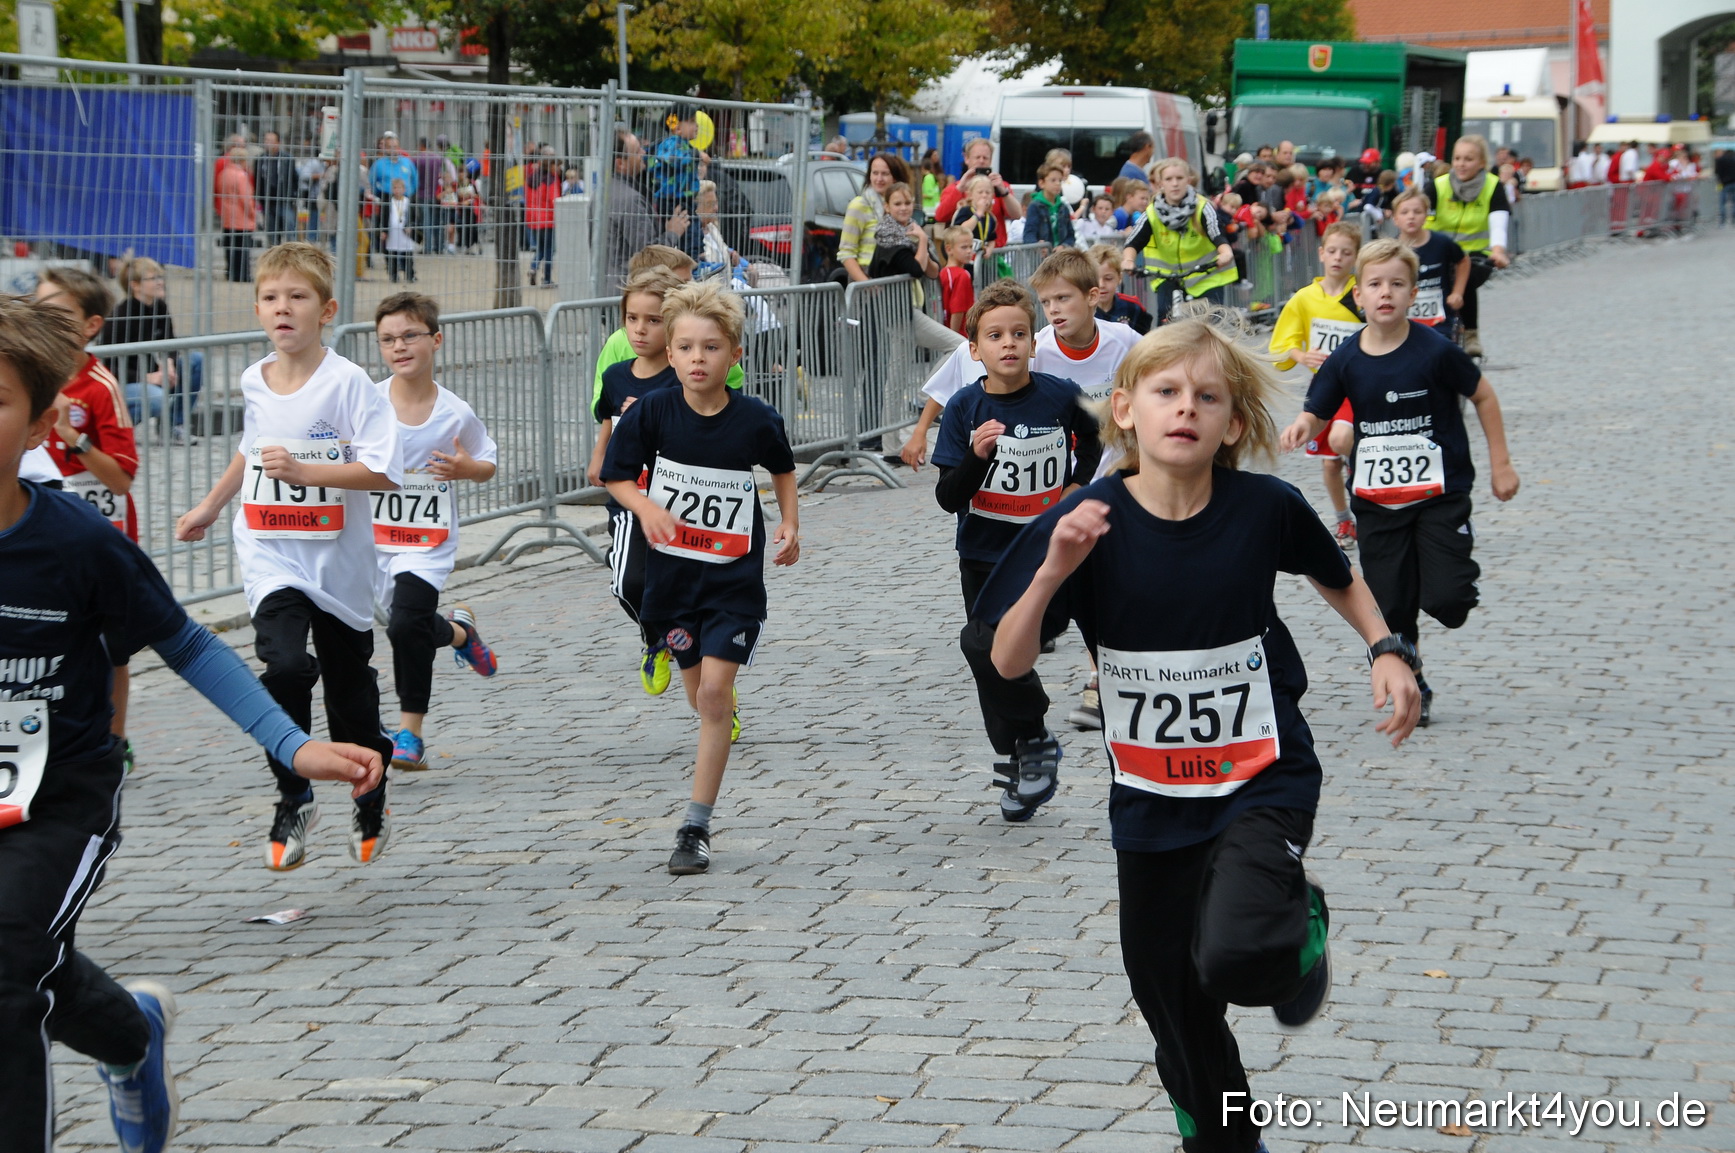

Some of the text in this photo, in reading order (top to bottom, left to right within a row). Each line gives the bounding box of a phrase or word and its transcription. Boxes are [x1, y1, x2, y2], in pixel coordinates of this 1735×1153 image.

[394, 31, 436, 49] NKD
[1317, 331, 1350, 352] 70
[1008, 444, 1054, 457] Neumarkt
[1359, 444, 1425, 454] PARTL Neumarkt
[656, 467, 688, 484] PARTL
[690, 476, 740, 490] Neumarkt
[984, 456, 1058, 492] 7310
[1364, 455, 1431, 486] 7332
[369, 492, 441, 524] 7074
[663, 485, 744, 530] 7267
[977, 496, 1031, 512] Maximilian
[259, 510, 319, 527] Yannick
[390, 529, 420, 543] Elias
[681, 531, 713, 549] Luis
[1102, 662, 1155, 682] PARTL
[1158, 661, 1241, 682] Neumarkt
[1117, 682, 1251, 744] 7257
[1261, 725, 1271, 736] M
[1165, 755, 1217, 778] Luis
